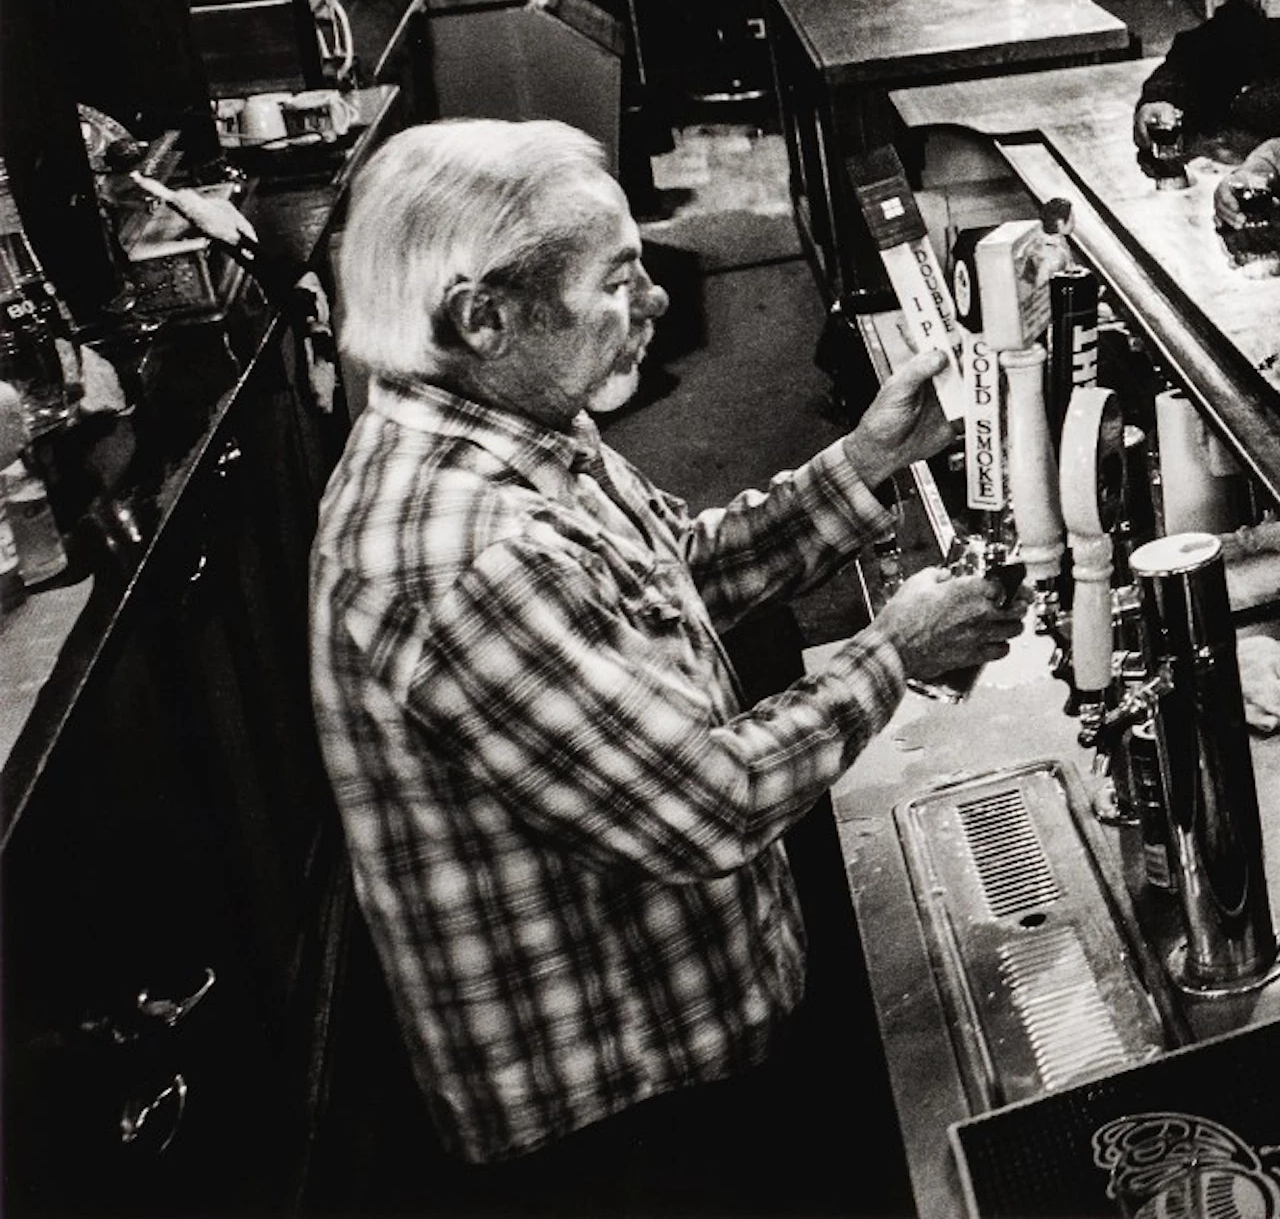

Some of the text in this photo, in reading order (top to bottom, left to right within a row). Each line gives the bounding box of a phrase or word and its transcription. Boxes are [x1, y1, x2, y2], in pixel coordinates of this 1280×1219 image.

[914, 249, 954, 333] DOUBLE
[972, 341, 992, 405] COLD
[976, 420, 995, 498] SMOKE
